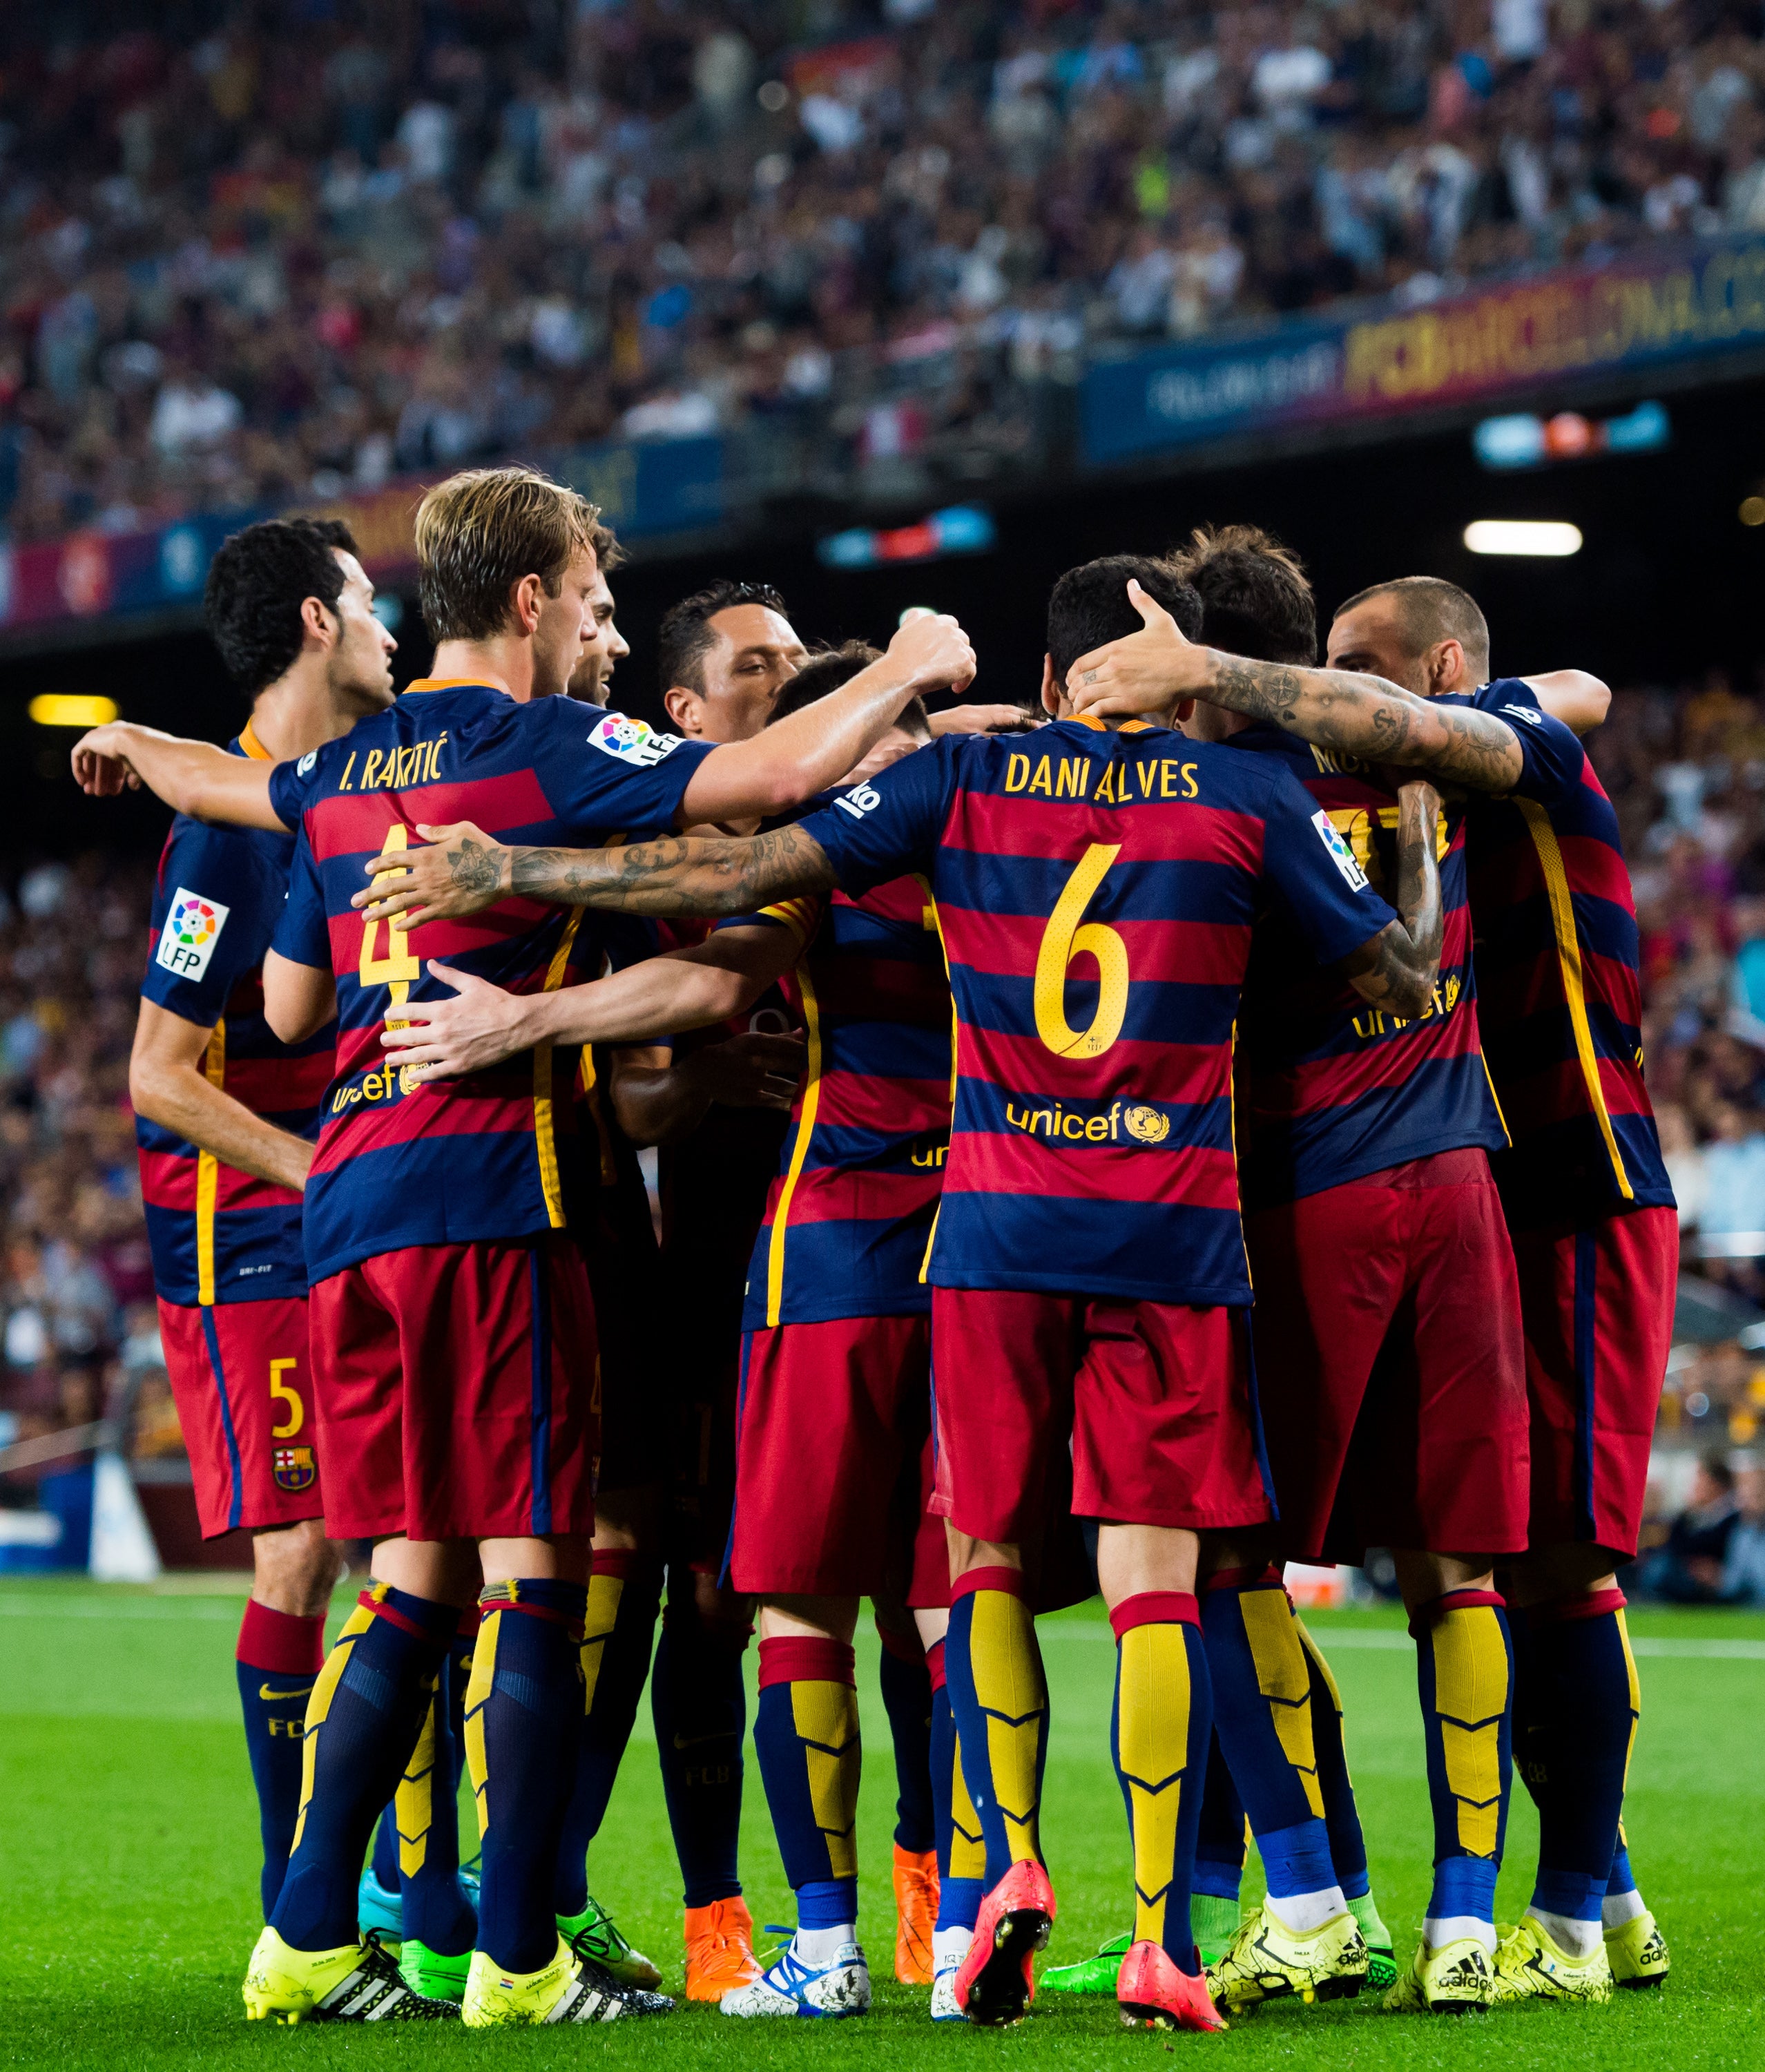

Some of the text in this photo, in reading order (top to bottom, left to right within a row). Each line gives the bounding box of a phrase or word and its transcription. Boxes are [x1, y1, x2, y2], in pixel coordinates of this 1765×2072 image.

[1005, 753, 1199, 804] DANI ALVES
[359, 823, 420, 1032] 4
[162, 941, 201, 972] LFP
[1034, 843, 1129, 1059] 6
[1005, 1102, 1121, 1141] unicef
[269, 1357, 305, 1439] 5
[268, 1718, 304, 1738] FC
[1438, 1972, 1493, 1993] adidas
